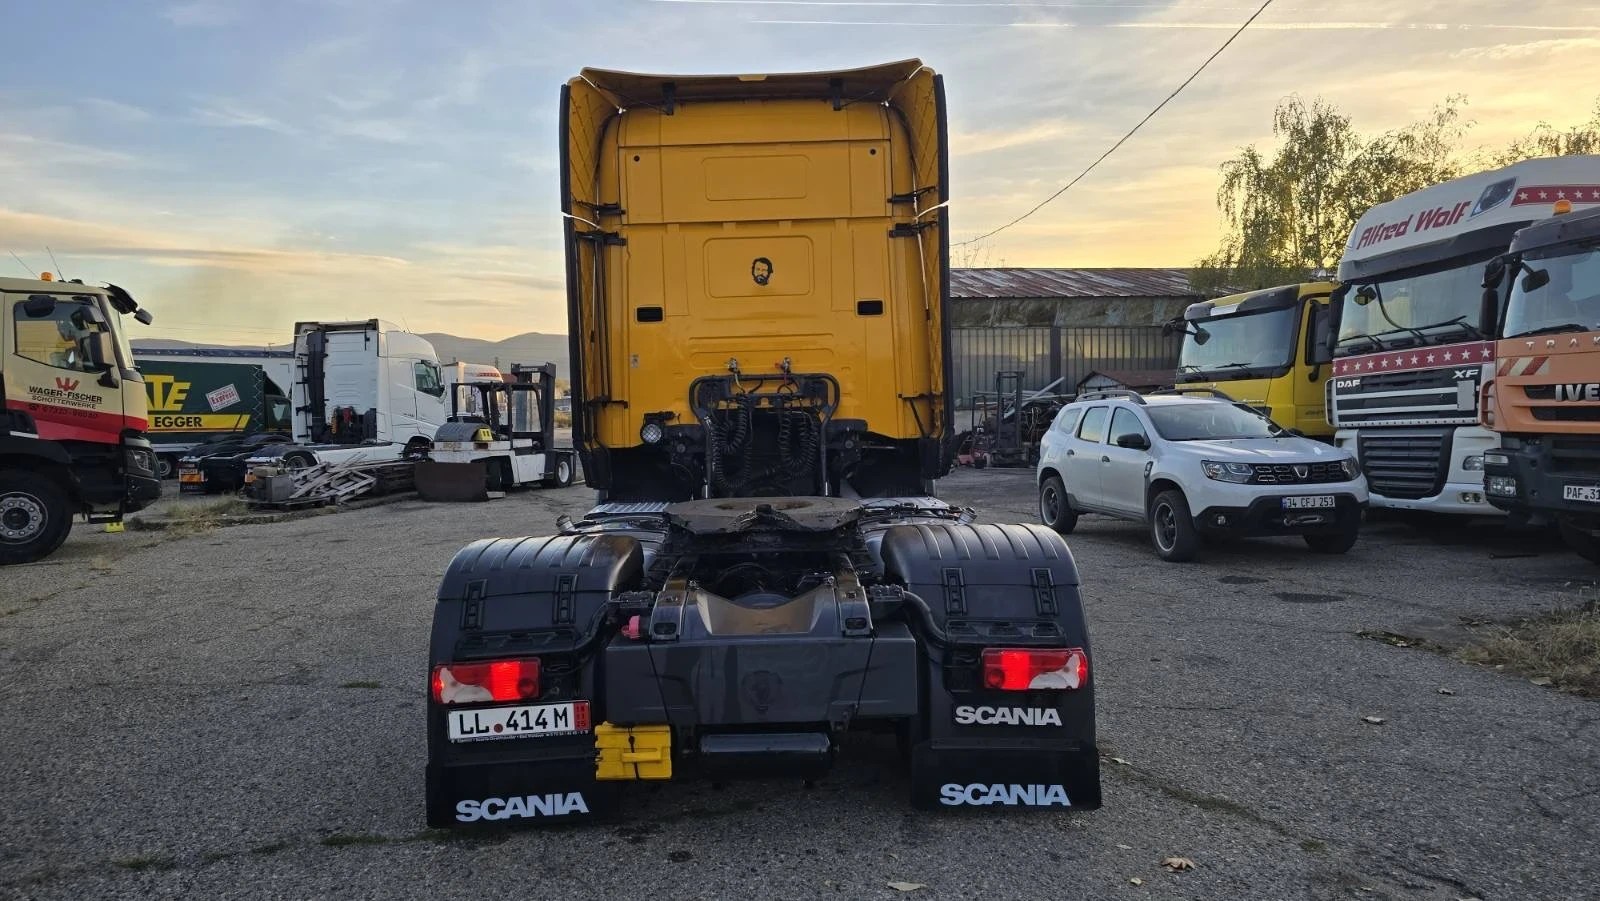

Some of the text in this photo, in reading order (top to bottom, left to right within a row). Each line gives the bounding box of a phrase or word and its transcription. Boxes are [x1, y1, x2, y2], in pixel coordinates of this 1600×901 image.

[1356, 200, 1472, 250] Alfred Wolf
[1452, 369, 1479, 379] XF
[1337, 379, 1361, 388] DAF
[31, 395, 97, 409] SCHOTTERWERKE
[209, 391, 235, 405] Express
[154, 416, 202, 428] EGGER
[1566, 487, 1583, 498] PAF
[1287, 498, 1297, 508] 34
[1301, 497, 1316, 508] CFJ
[1320, 496, 1334, 507] 253
[459, 707, 569, 735] LL 414 M
[955, 705, 1062, 726] SCANIA
[940, 783, 1071, 806] SCANIA
[455, 792, 589, 822] SCANIA
